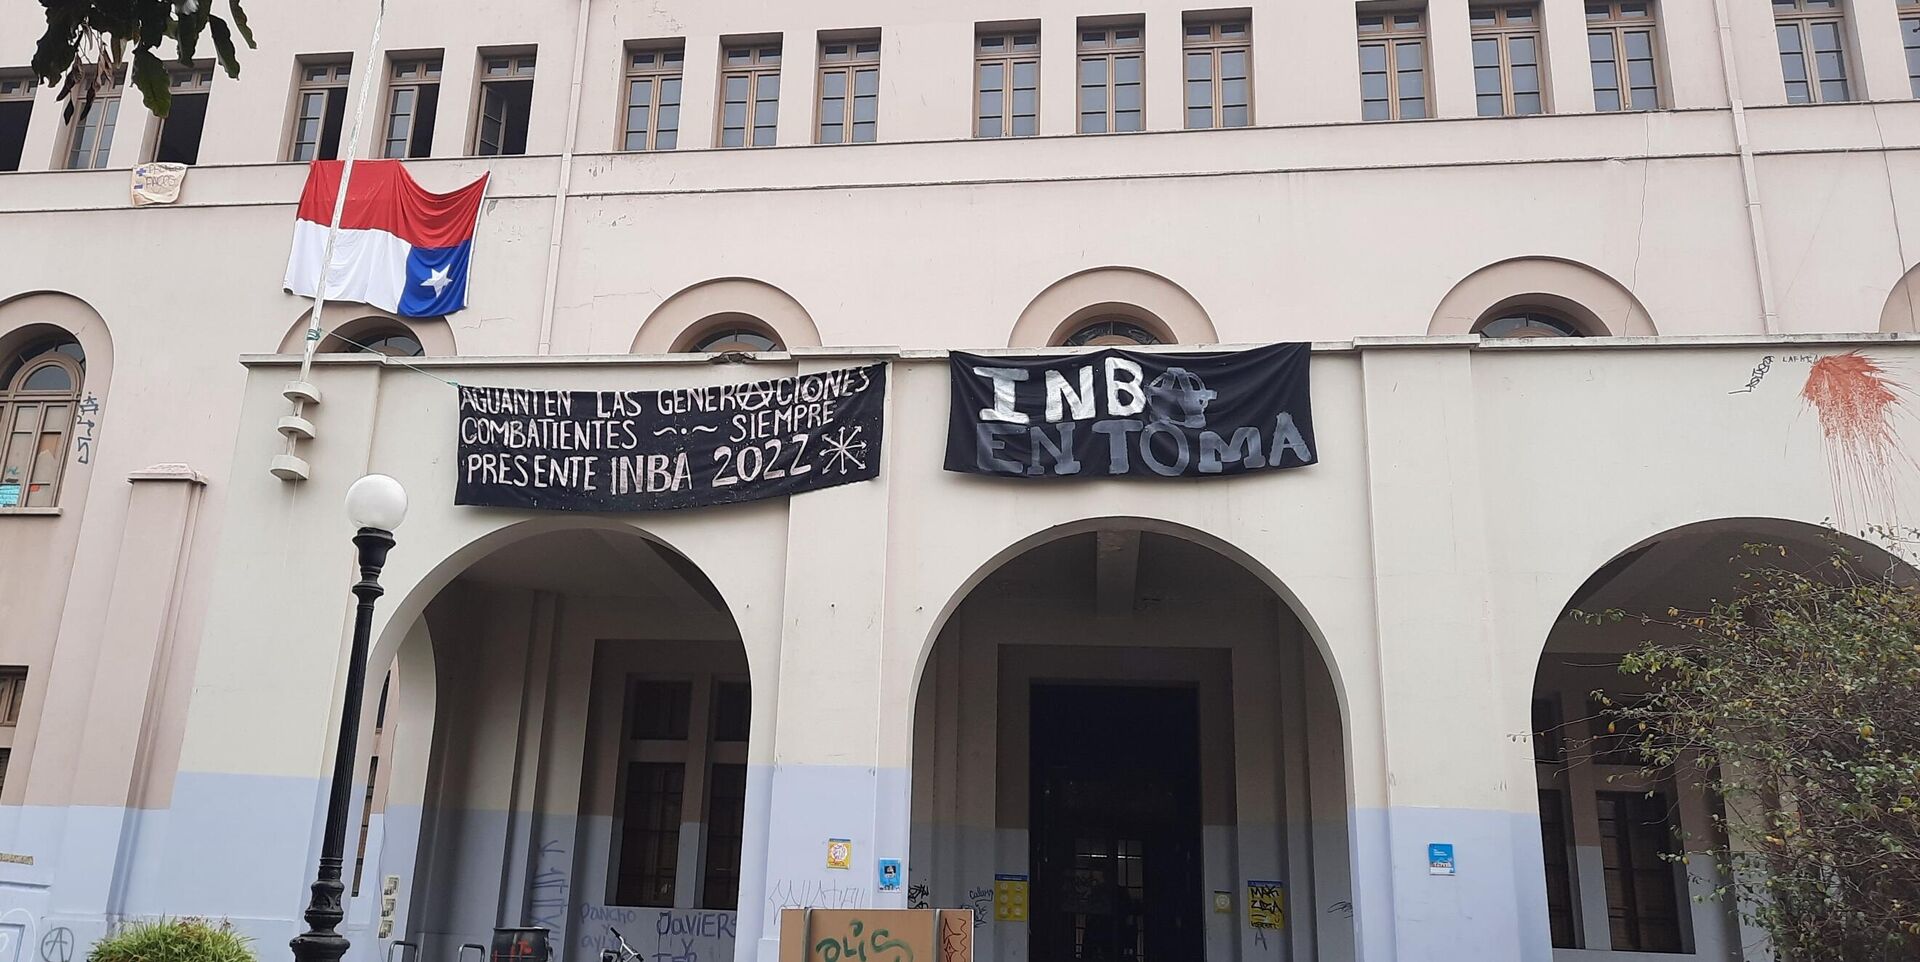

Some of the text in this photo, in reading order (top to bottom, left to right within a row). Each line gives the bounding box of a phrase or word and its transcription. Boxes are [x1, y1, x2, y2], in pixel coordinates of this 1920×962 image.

[461, 368, 870, 418] AGUANTEN LAS GENERACIONES
[461, 400, 838, 451] COMBATIENTES SIEMPRE
[976, 411, 1312, 476] EN TOMA
[467, 452, 599, 491] PRESENTE
[610, 452, 693, 495] INBA
